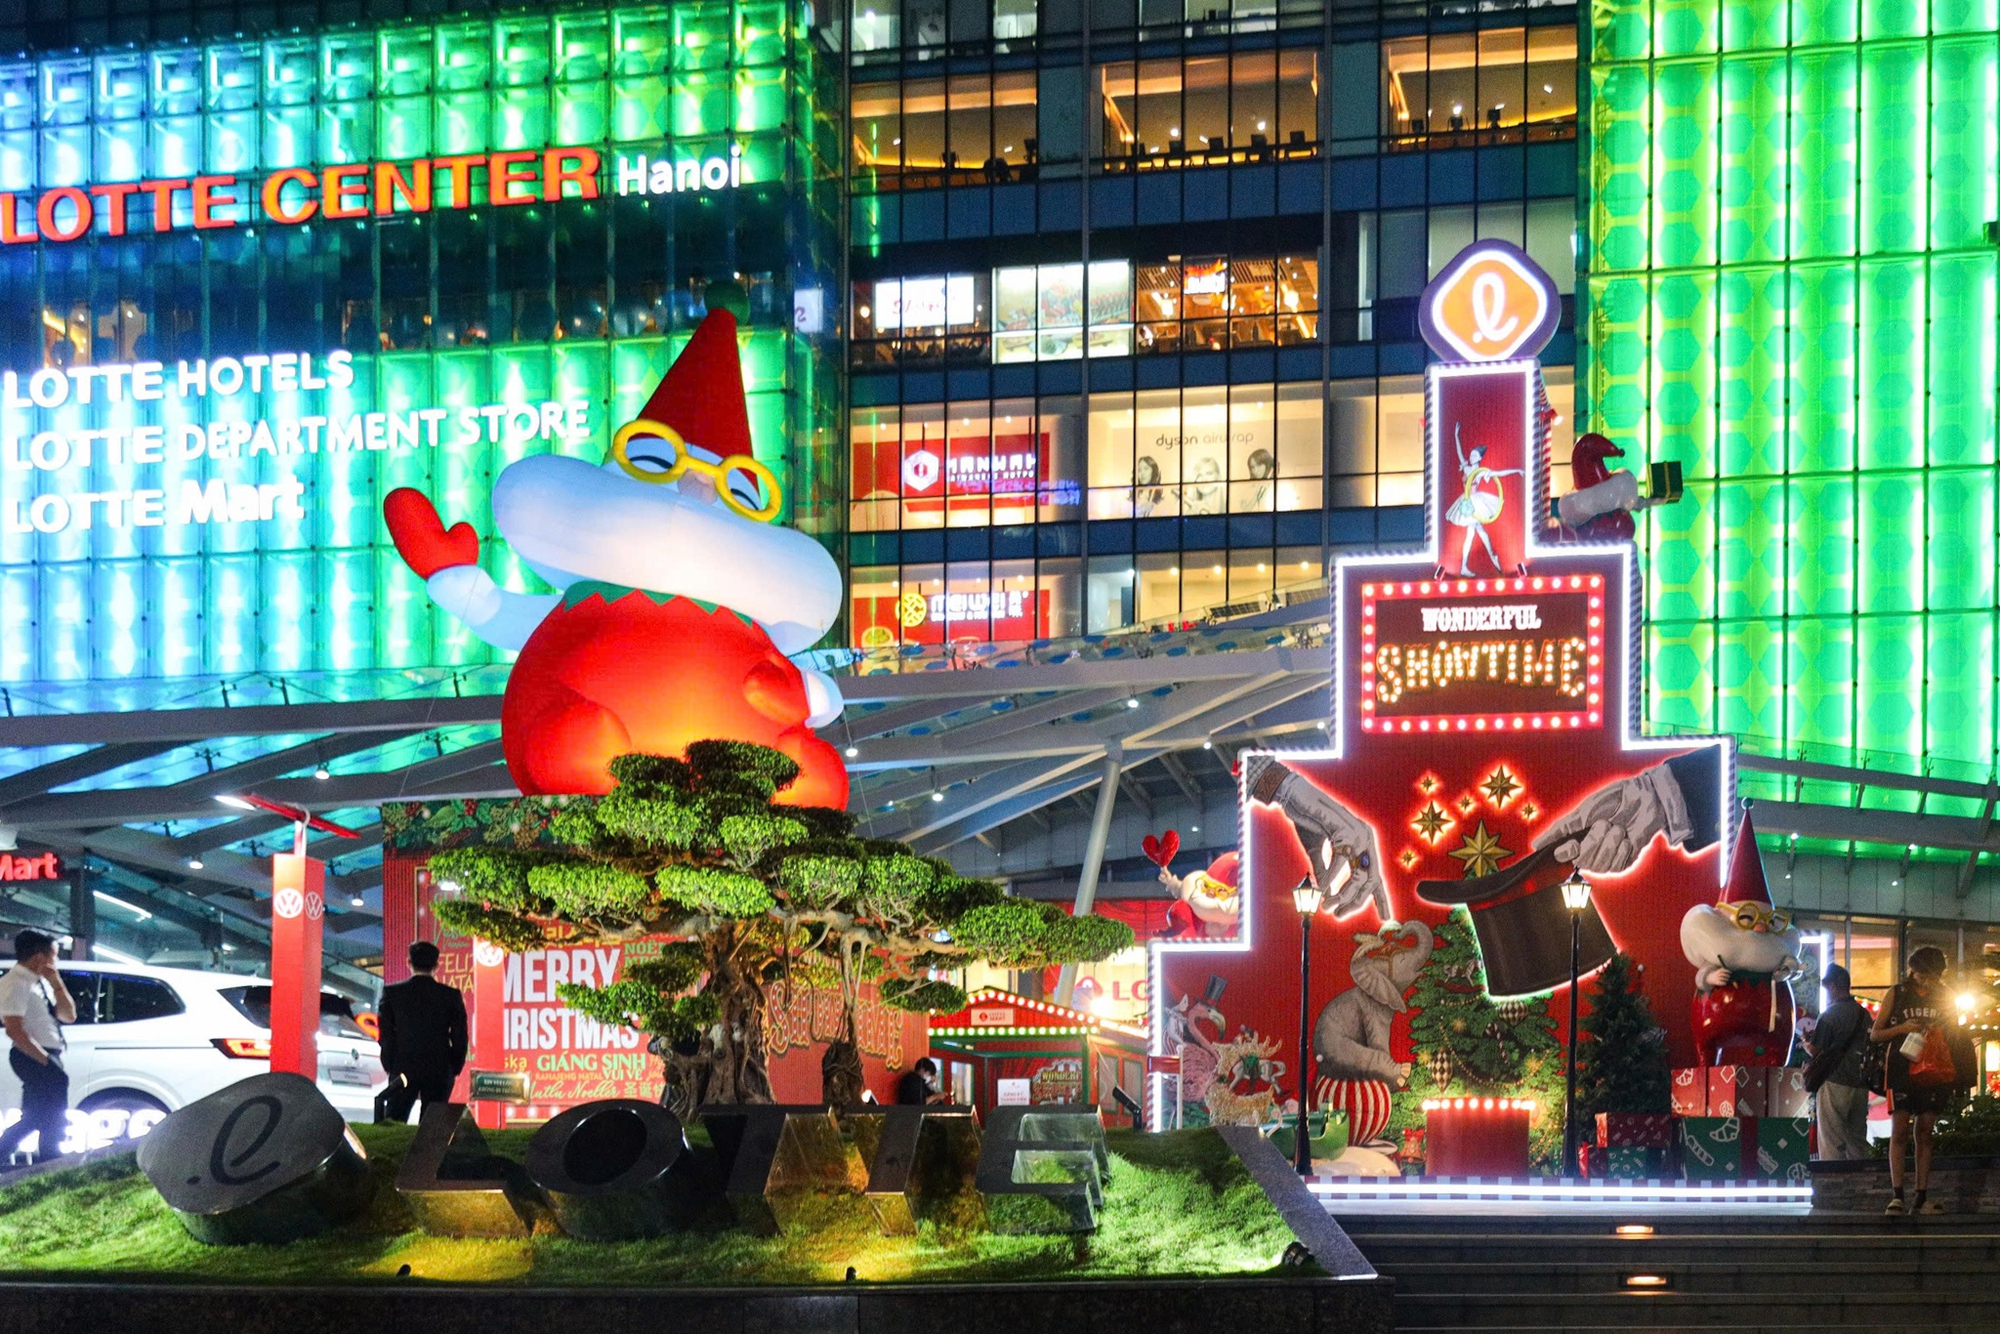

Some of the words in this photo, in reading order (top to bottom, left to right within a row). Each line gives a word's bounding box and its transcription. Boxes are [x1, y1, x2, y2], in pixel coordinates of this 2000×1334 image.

[0, 175, 237, 244] LOTTE
[262, 147, 600, 225] CENTER
[618, 145, 742, 197] Hanoi
[3, 362, 164, 409] LOTTE
[178, 350, 354, 397] HOTELS
[3, 426, 165, 471] LOTTE
[177, 408, 447, 461] DEPARTMENT
[457, 400, 590, 445] STORE
[1156, 434, 1198, 450] dyson
[5, 490, 164, 533] LOTTE
[180, 475, 305, 524] Mart
[1421, 604, 1541, 632] WONDERFUL
[1376, 637, 1586, 704] SHOWTIME
[537, 1051, 598, 1071] GIÁNG
[602, 1053, 646, 1070] SINH
[602, 1069, 624, 1080] VUI
